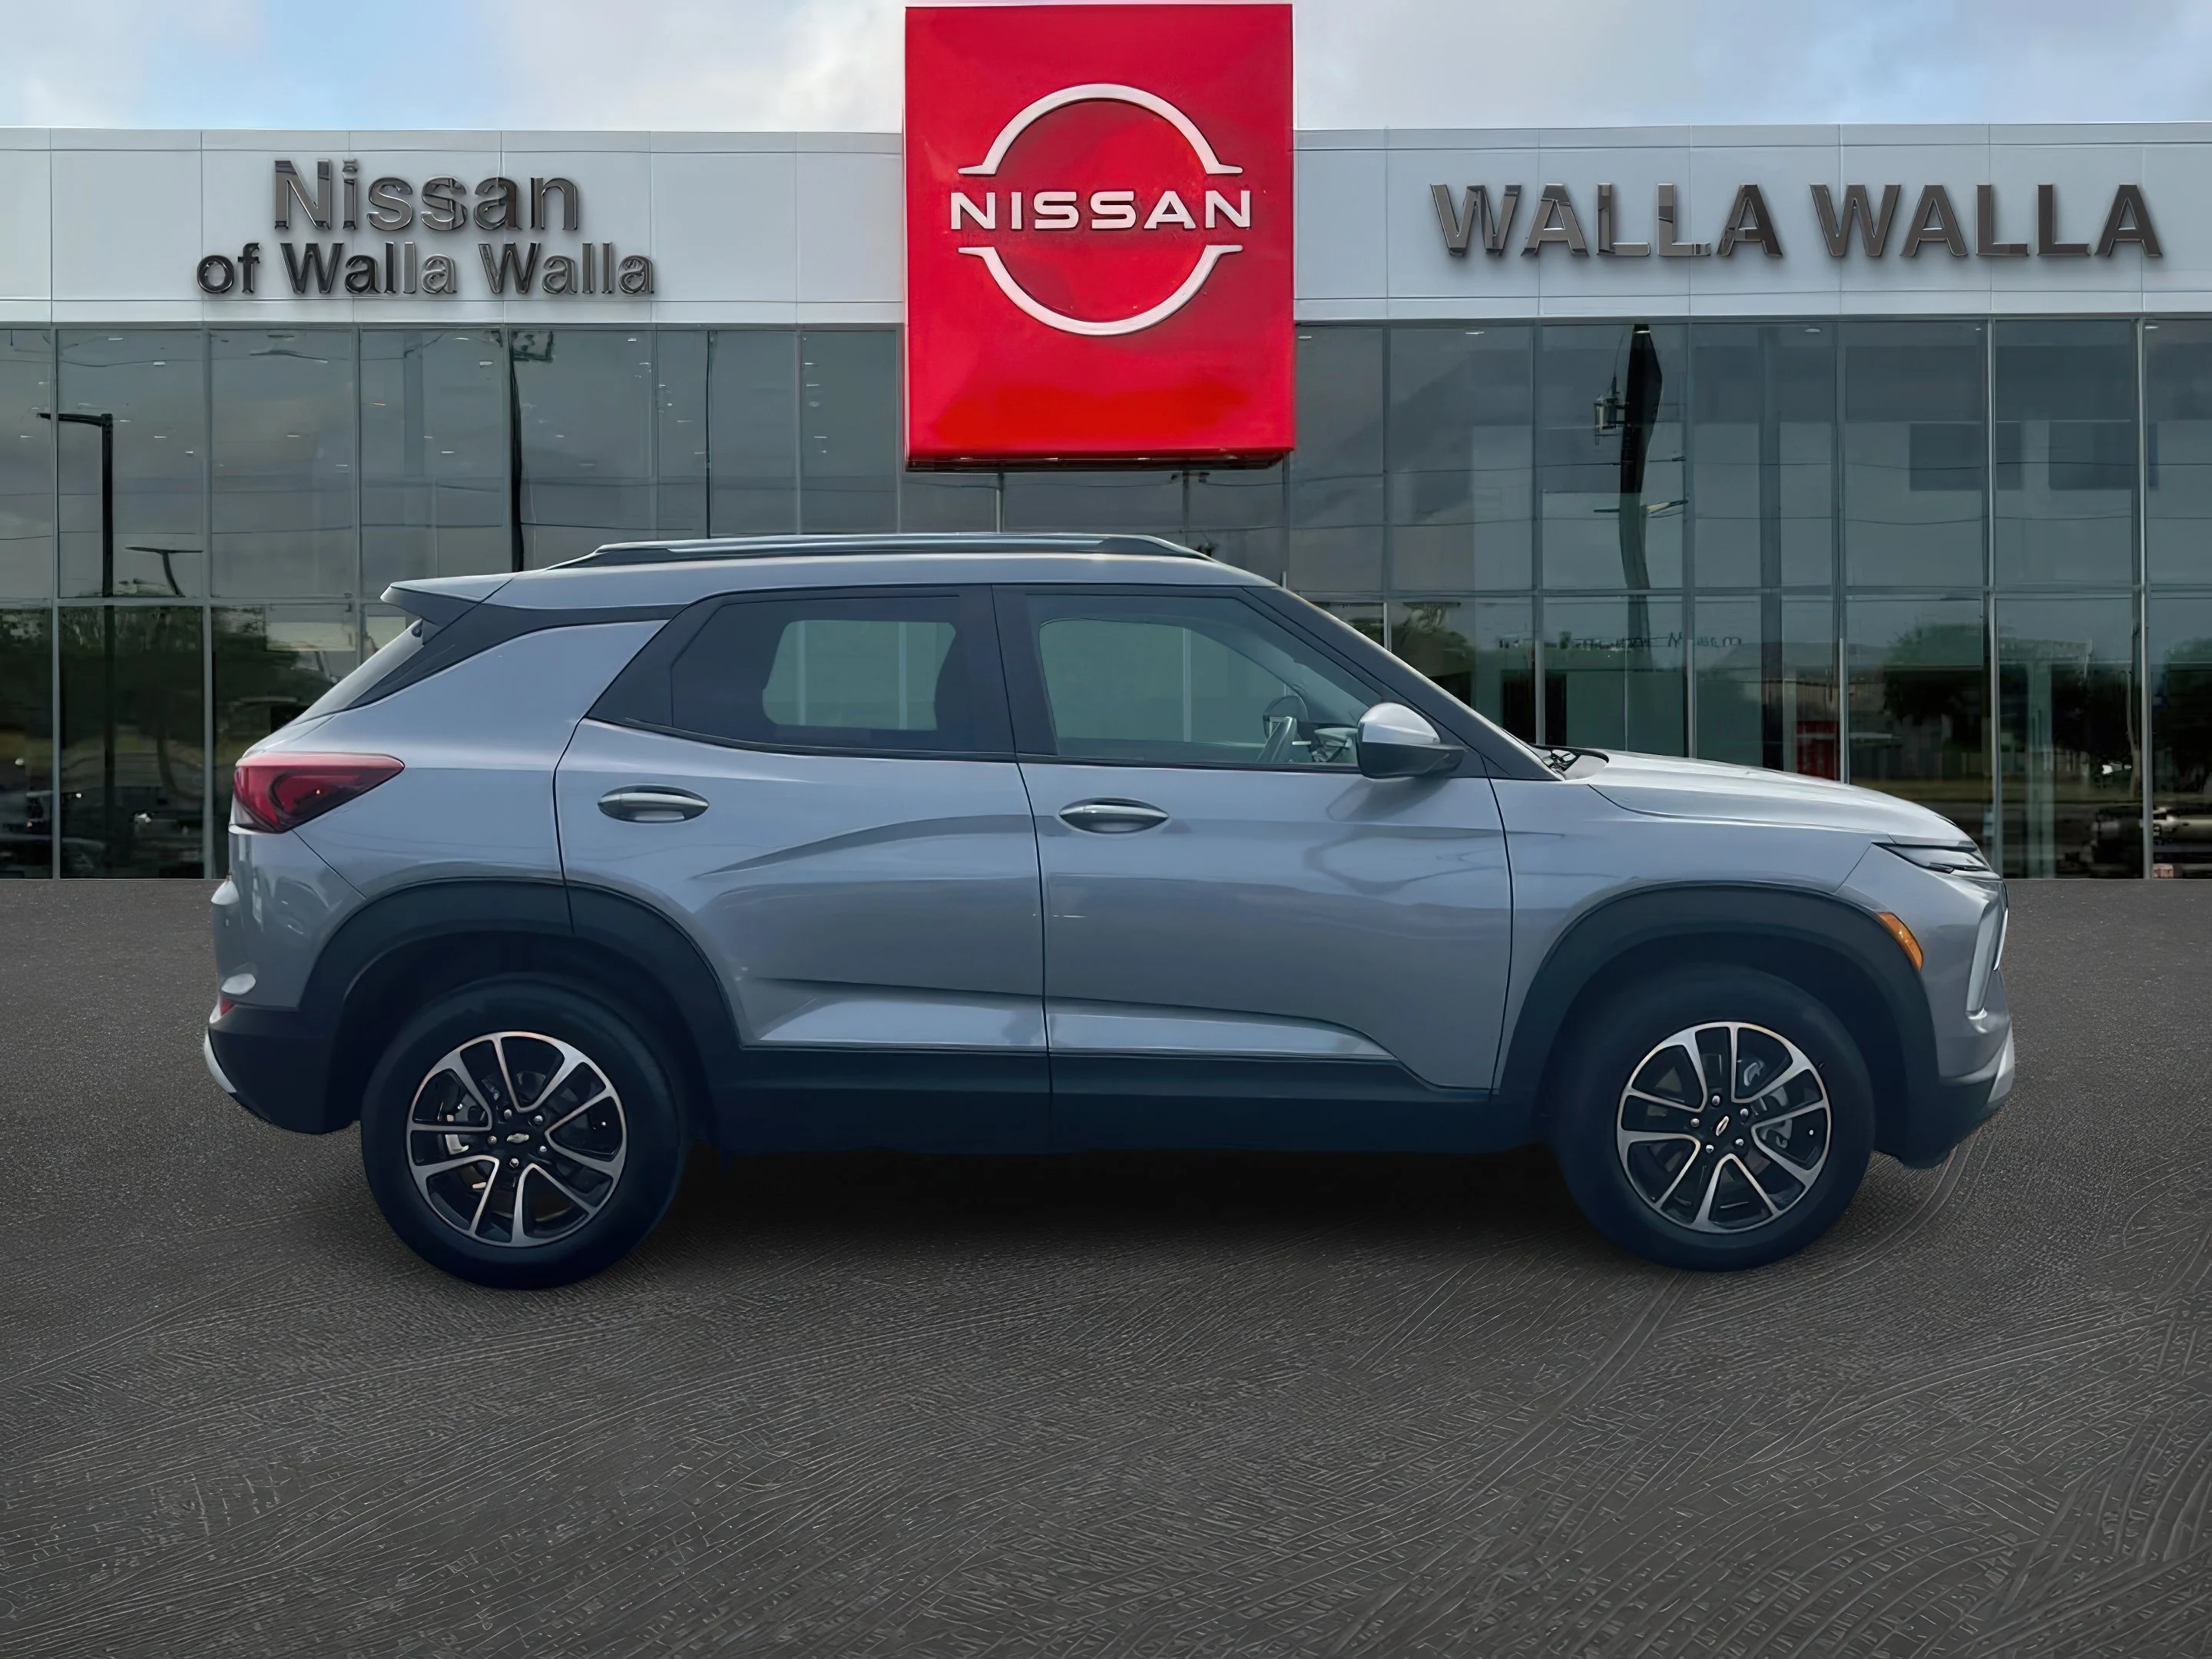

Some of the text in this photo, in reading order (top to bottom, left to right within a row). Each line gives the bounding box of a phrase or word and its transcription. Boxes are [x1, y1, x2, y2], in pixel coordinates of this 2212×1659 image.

[273, 158, 578, 230] Nissan
[951, 190, 1251, 230] NISSAN
[1430, 184, 2162, 257] WALLA WALLA
[196, 241, 655, 294] of Walla Walla
